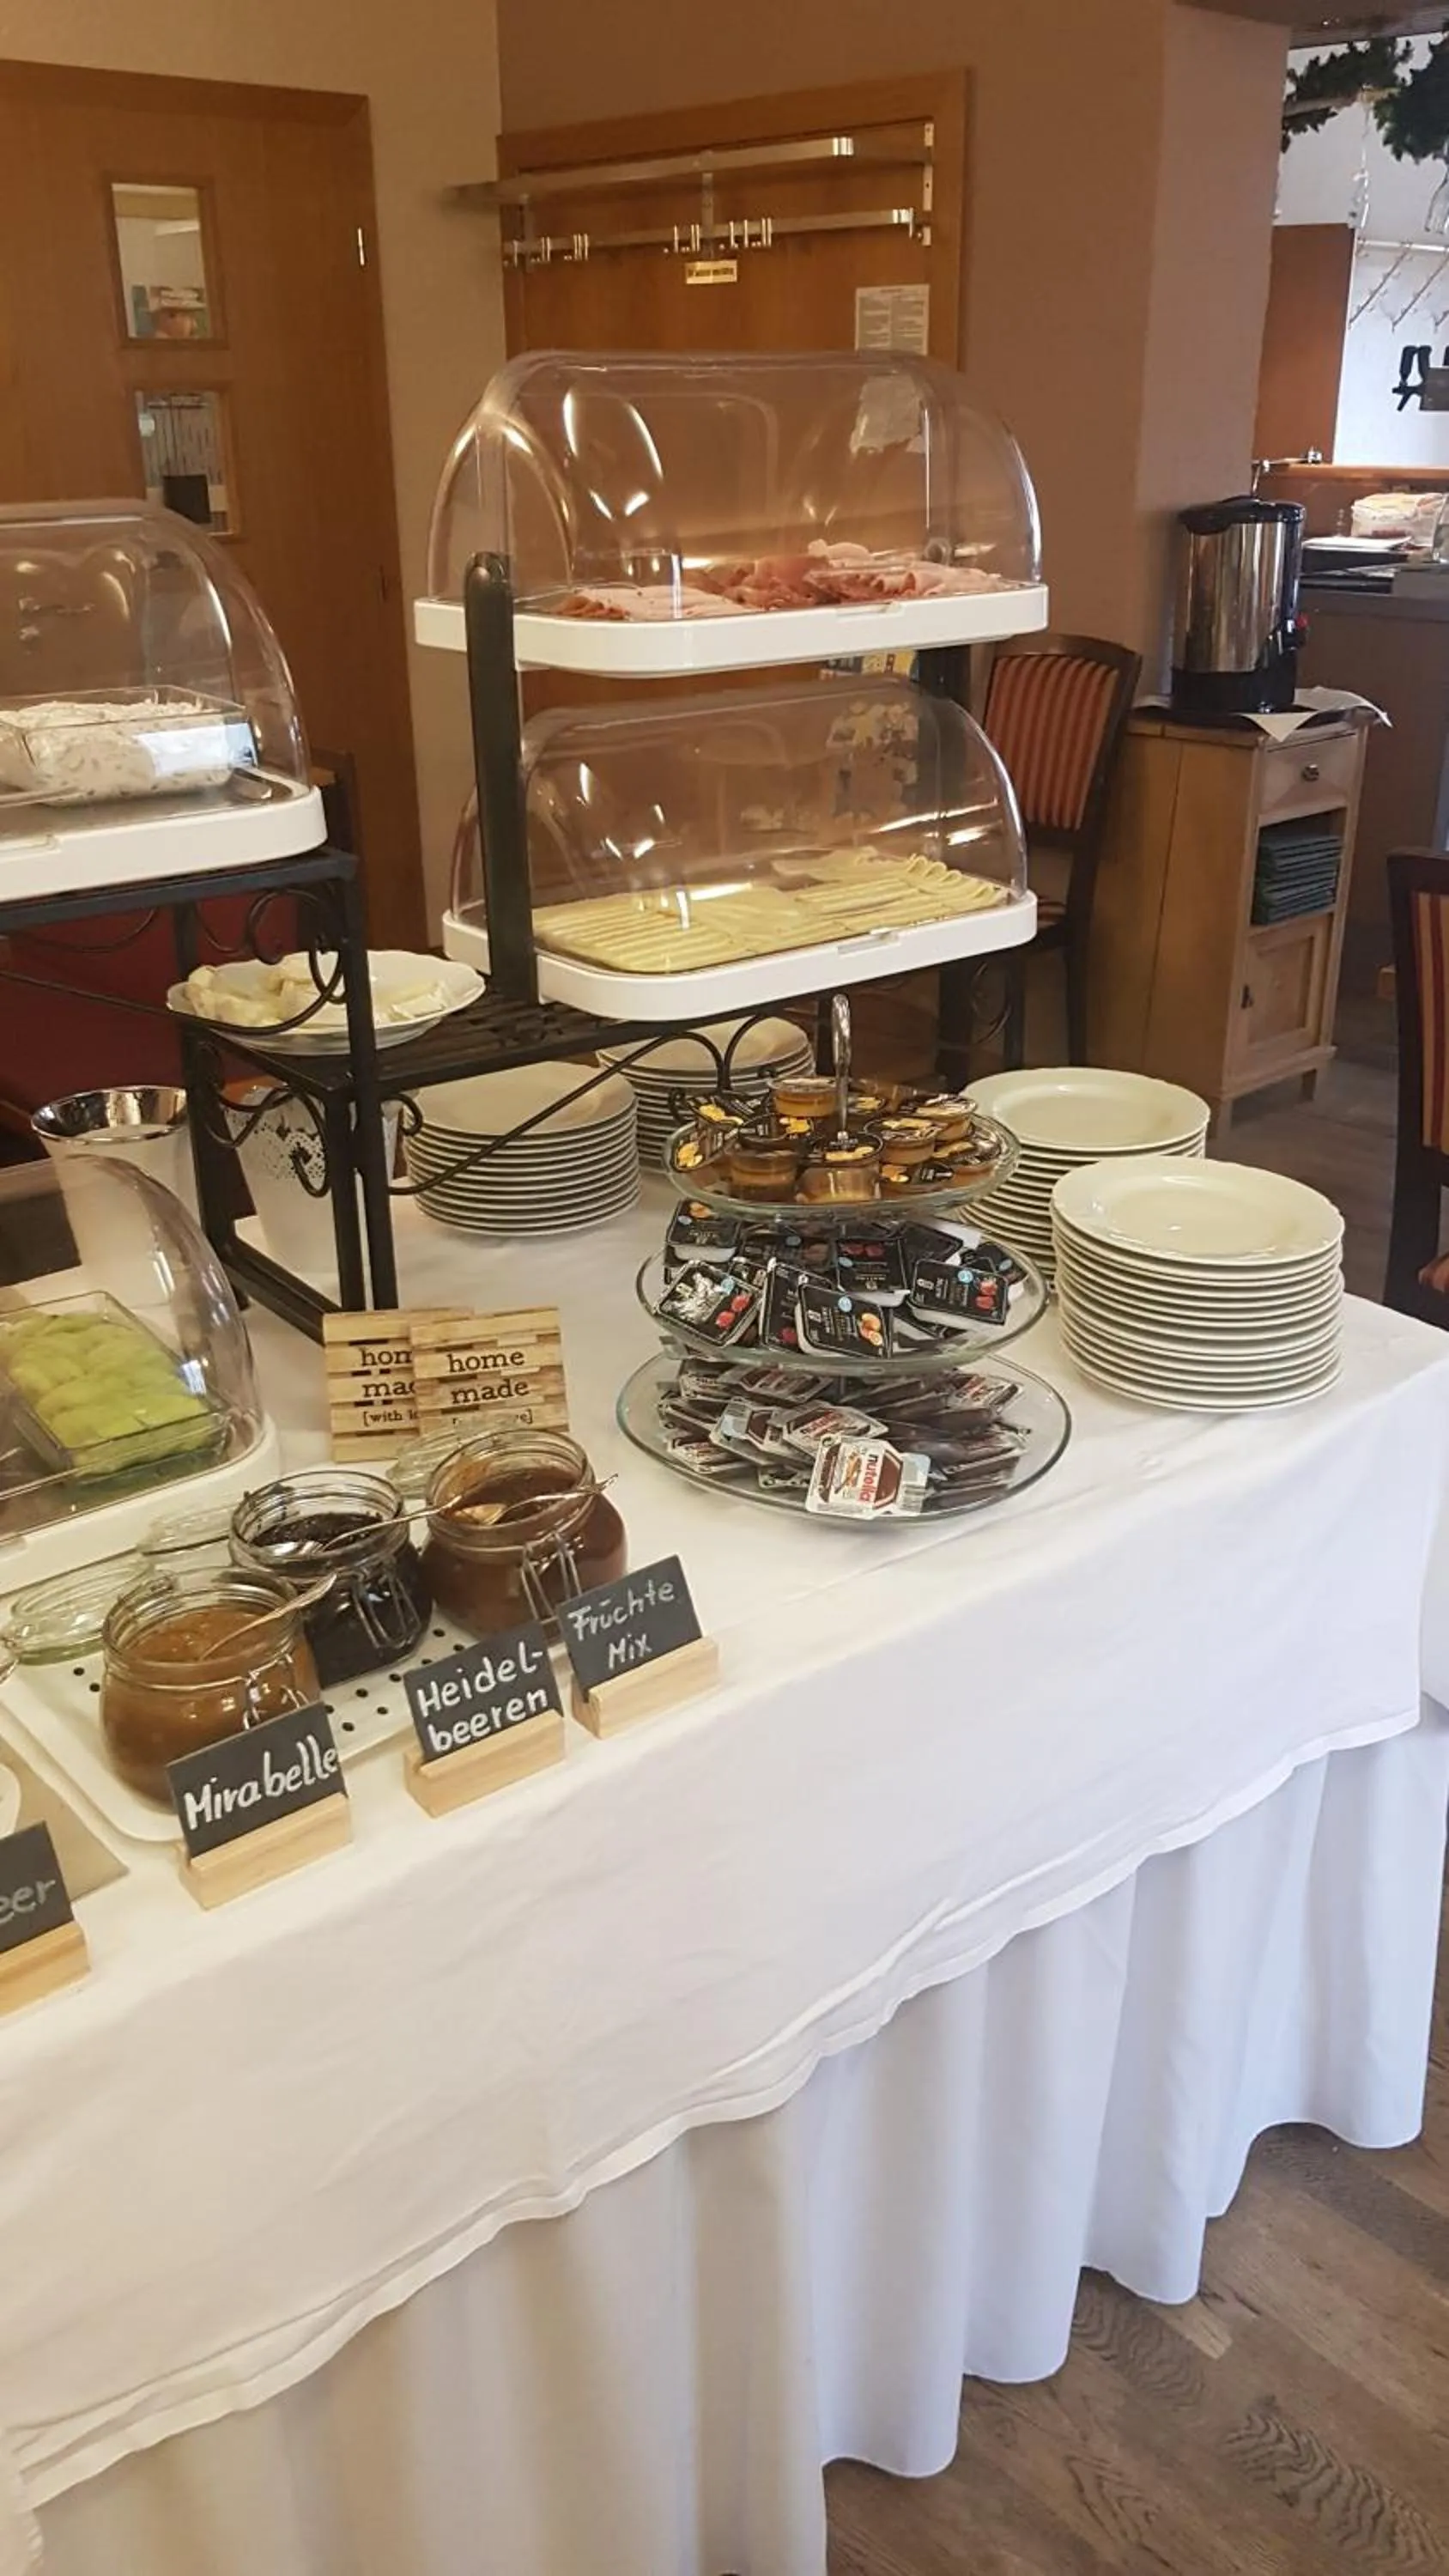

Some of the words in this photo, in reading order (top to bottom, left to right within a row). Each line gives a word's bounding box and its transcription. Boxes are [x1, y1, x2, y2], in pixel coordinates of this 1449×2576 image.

[361, 1349, 413, 1367] hom
[446, 1350, 525, 1373] home
[451, 1378, 531, 1405] made
[567, 1579, 675, 1641] Früchte
[607, 1633, 653, 1670] Mix
[416, 1641, 543, 1717] Heidel-
[428, 1687, 549, 1753] beeren
[183, 1734, 339, 1831] Mirabelle
